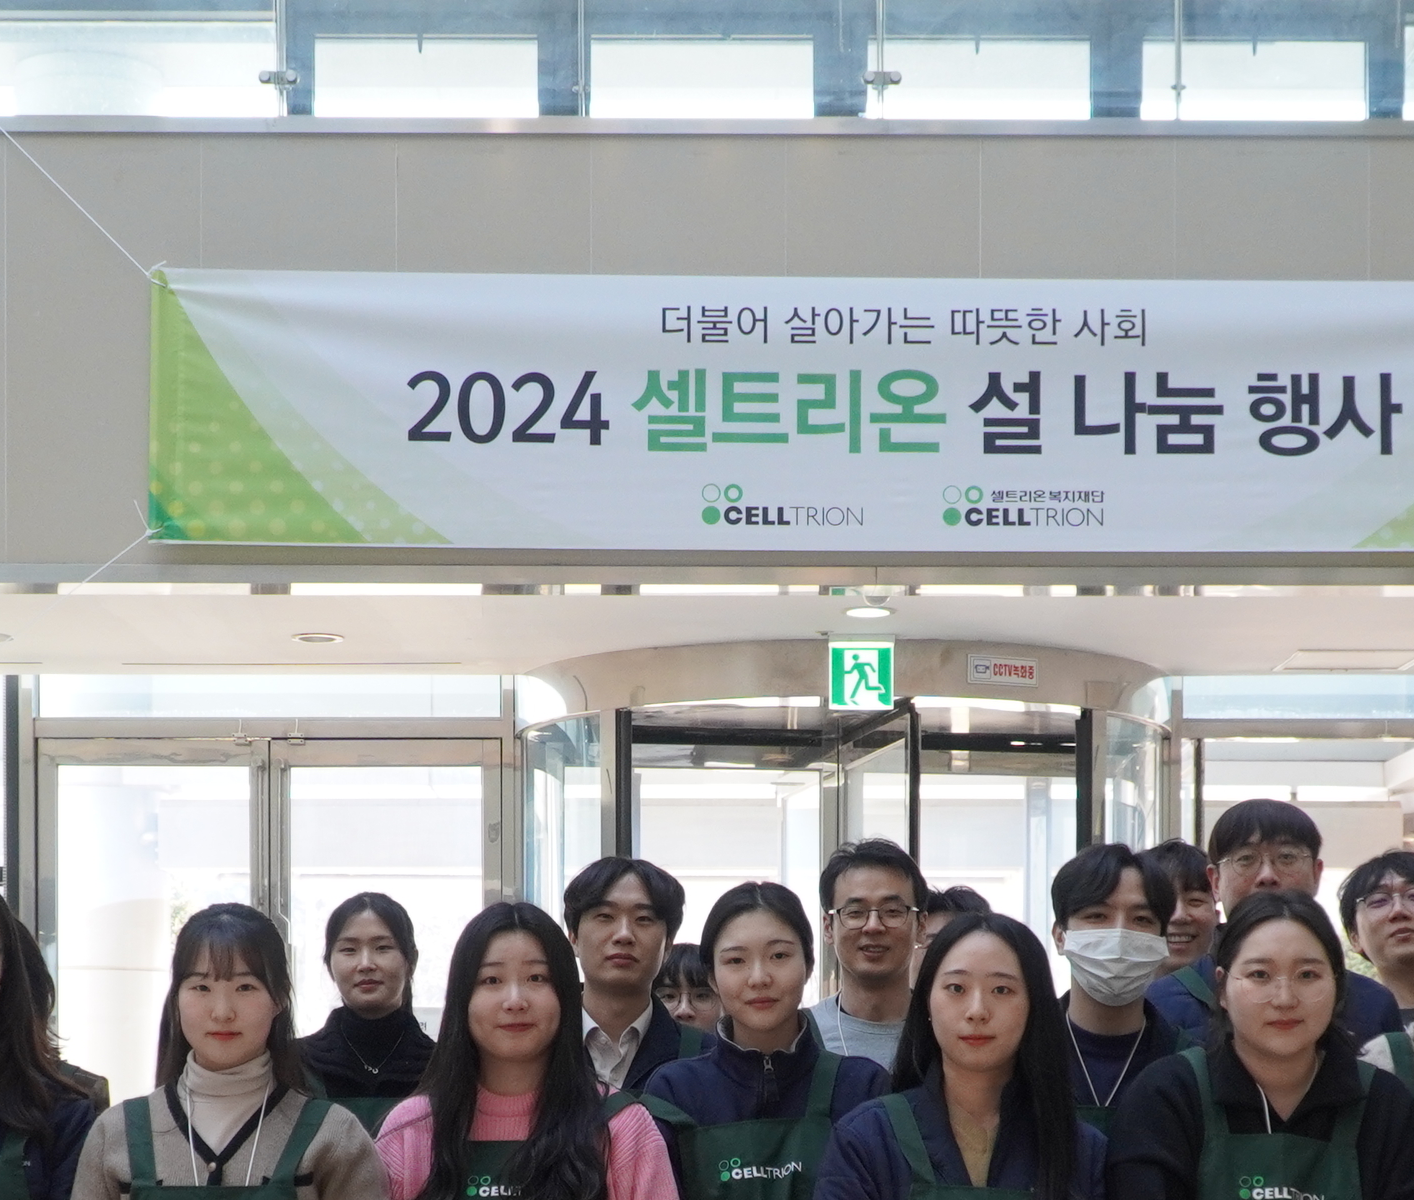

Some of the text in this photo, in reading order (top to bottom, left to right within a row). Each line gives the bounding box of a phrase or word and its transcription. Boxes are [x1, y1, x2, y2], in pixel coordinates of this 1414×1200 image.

[660, 305, 1147, 347] 더불어 살아가는 따뜻한 사회
[406, 367, 1404, 456] 2024 셀트리온 설 나눔 행사
[723, 505, 864, 527] CELLTRION
[964, 507, 1105, 527] CELLTRION
[731, 1161, 803, 1181] CELLTRION
